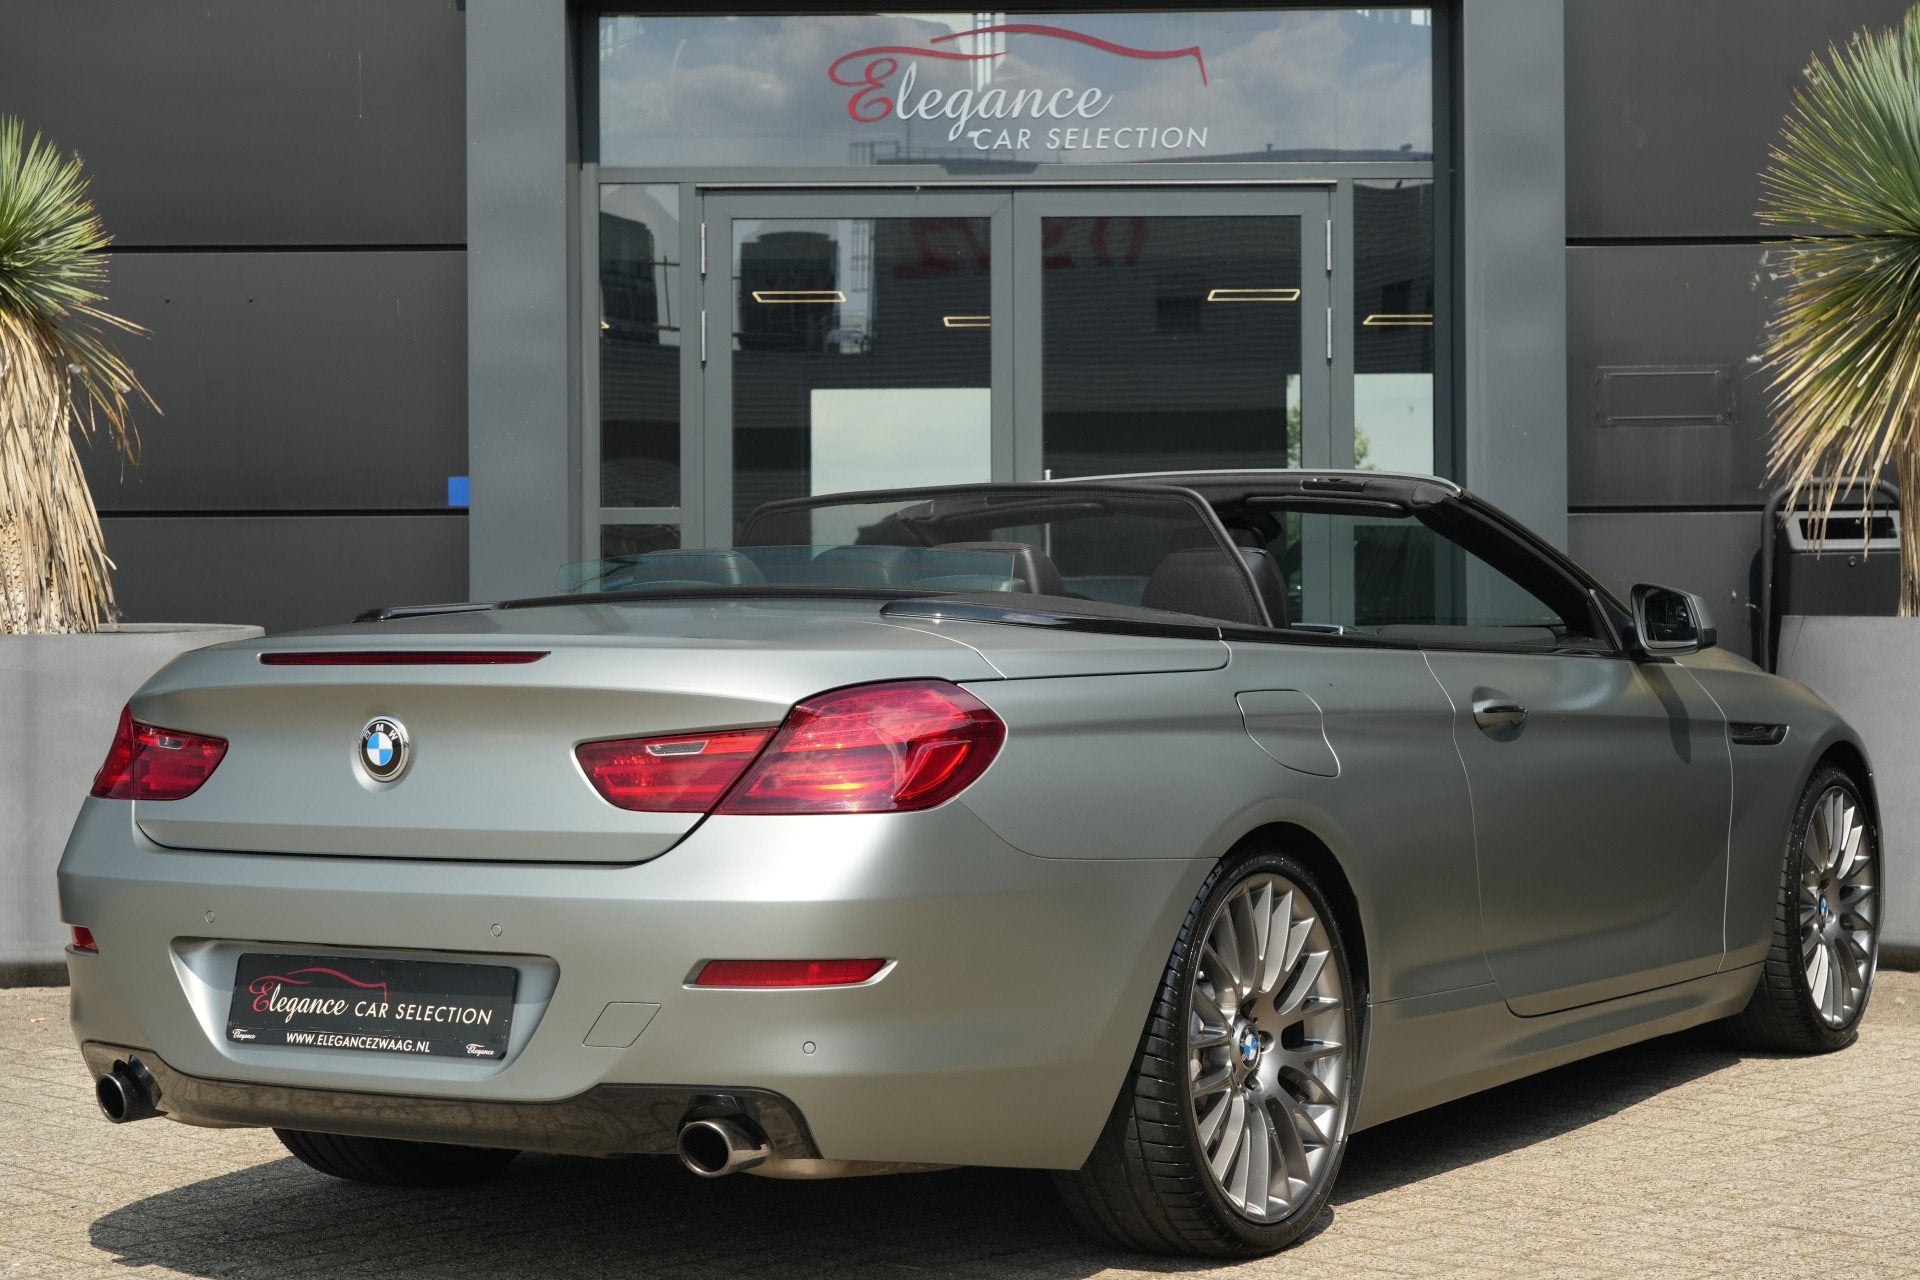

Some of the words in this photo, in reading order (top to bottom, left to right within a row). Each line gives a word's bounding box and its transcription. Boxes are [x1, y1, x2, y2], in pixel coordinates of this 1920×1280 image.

[828, 46, 1113, 142] Elegance
[972, 128, 1031, 149] CAR
[1046, 127, 1208, 149] SELECTION
[364, 723, 399, 740] BMW
[249, 975, 349, 1024] Elegance
[354, 1001, 389, 1018] CAR
[395, 1003, 492, 1025] SELECTION
[286, 1032, 430, 1053] WWW.ELEGANCEZWAAG.NL
